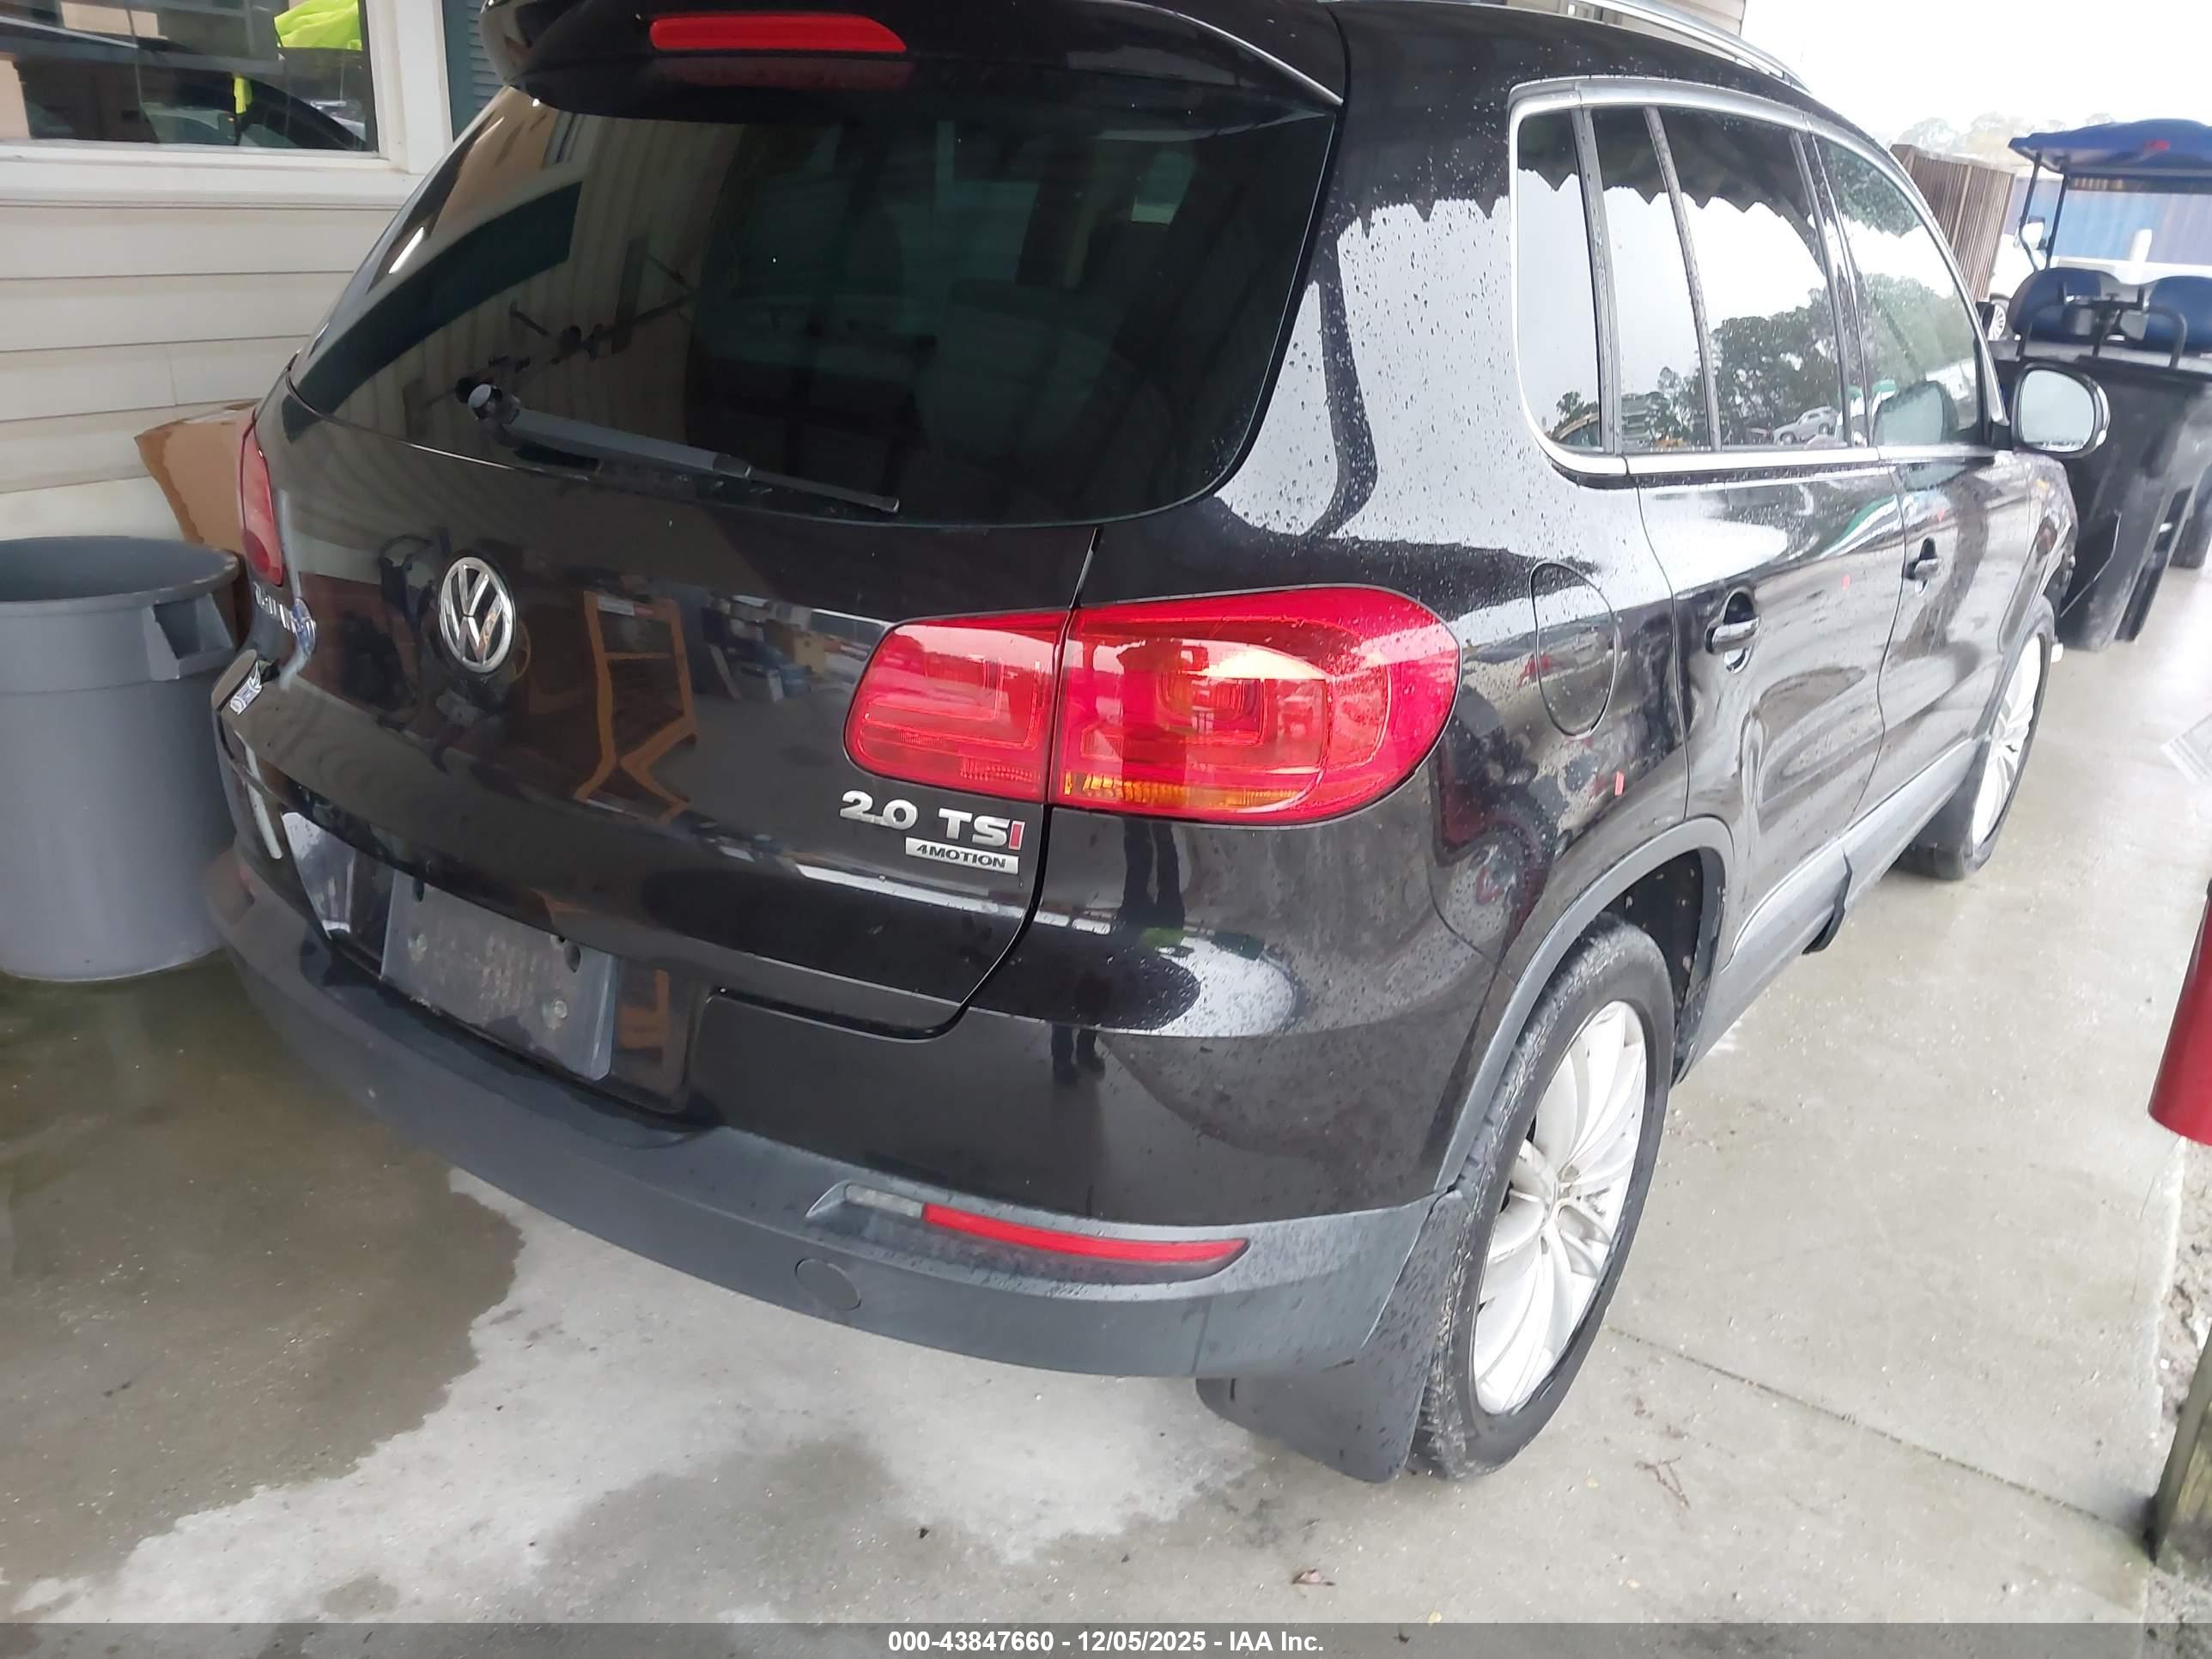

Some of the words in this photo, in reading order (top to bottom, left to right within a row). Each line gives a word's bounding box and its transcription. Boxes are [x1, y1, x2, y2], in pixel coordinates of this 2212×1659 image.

[839, 789, 919, 831] 2.0
[938, 806, 1026, 851] TSI
[915, 843, 1007, 869] 4MOTION
